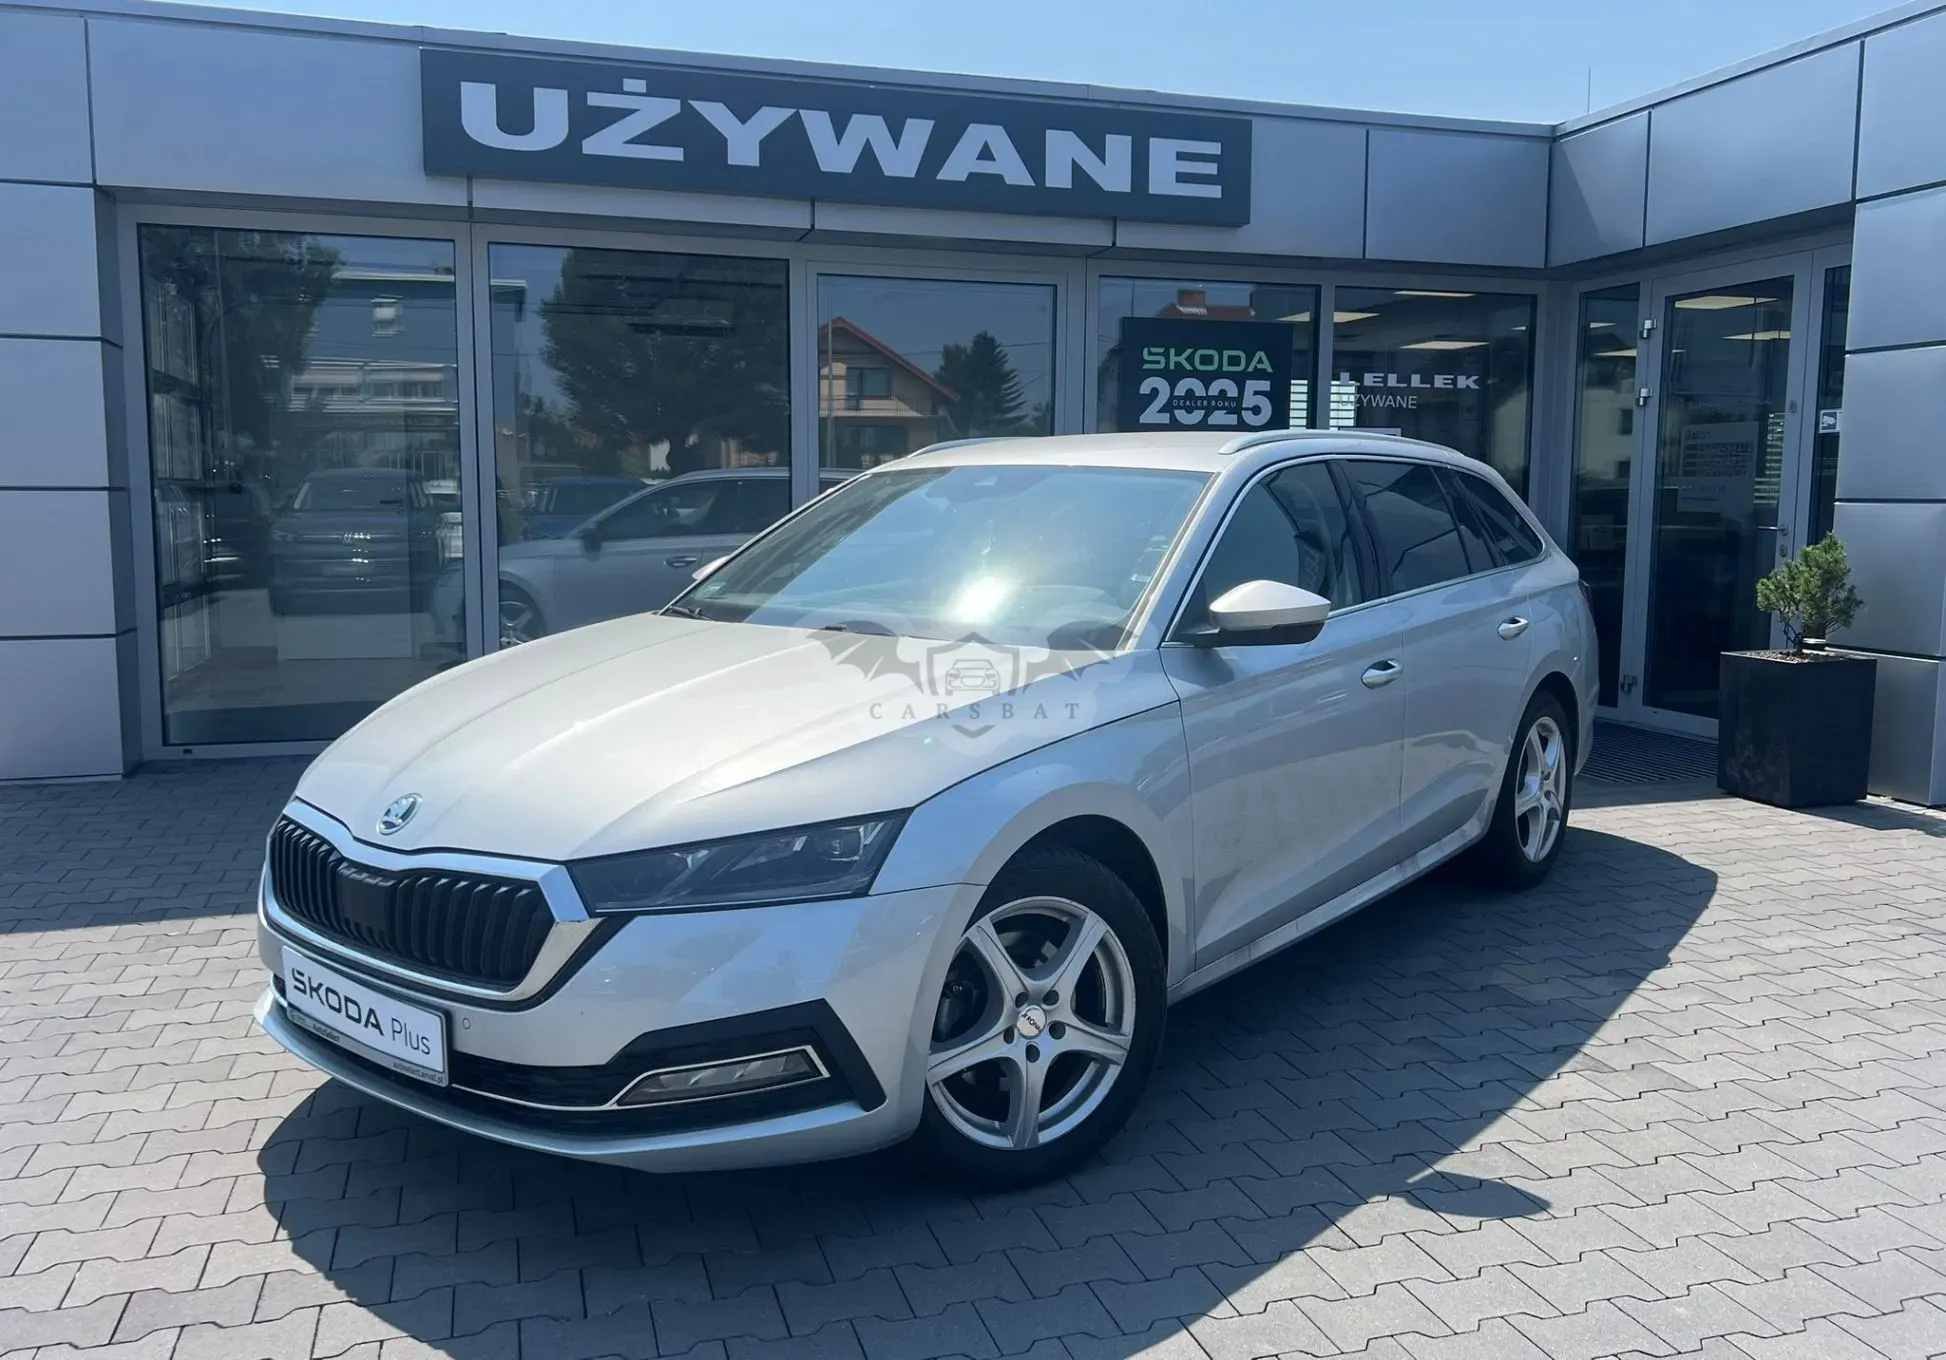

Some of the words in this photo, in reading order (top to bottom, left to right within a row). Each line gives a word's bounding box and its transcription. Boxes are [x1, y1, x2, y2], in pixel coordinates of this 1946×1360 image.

[460, 78, 1222, 199] UŻYWANE
[1340, 371, 1480, 389] LELLEK
[1139, 376, 1272, 427] 2025
[1172, 399, 1208, 407] DEALER
[1211, 400, 1237, 408] ROKU
[391, 1017, 431, 1055] Plus
